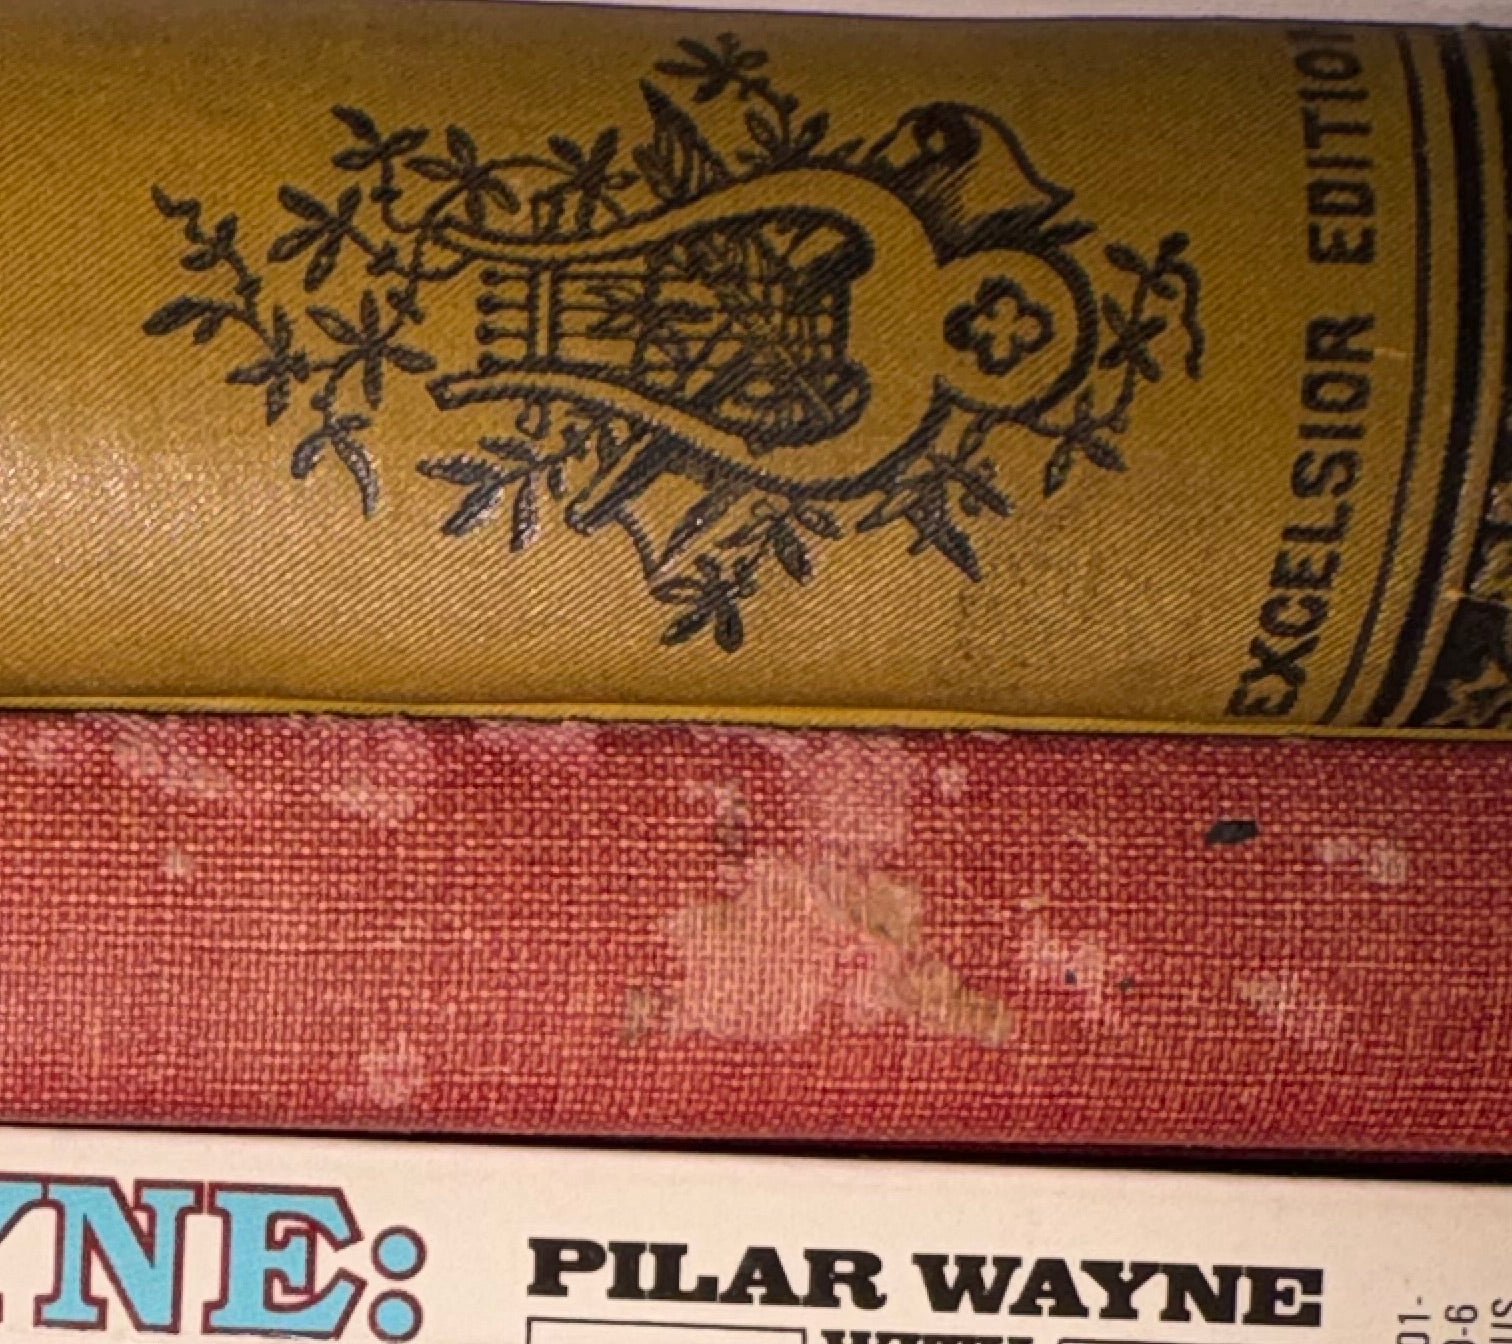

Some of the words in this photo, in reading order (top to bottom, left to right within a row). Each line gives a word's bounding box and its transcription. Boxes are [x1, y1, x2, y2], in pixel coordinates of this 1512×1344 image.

[1223, 312, 1376, 718] EXCELSIOR
[527, 1238, 887, 1310] PILAR
[912, 1253, 1324, 1328] WAYNE
